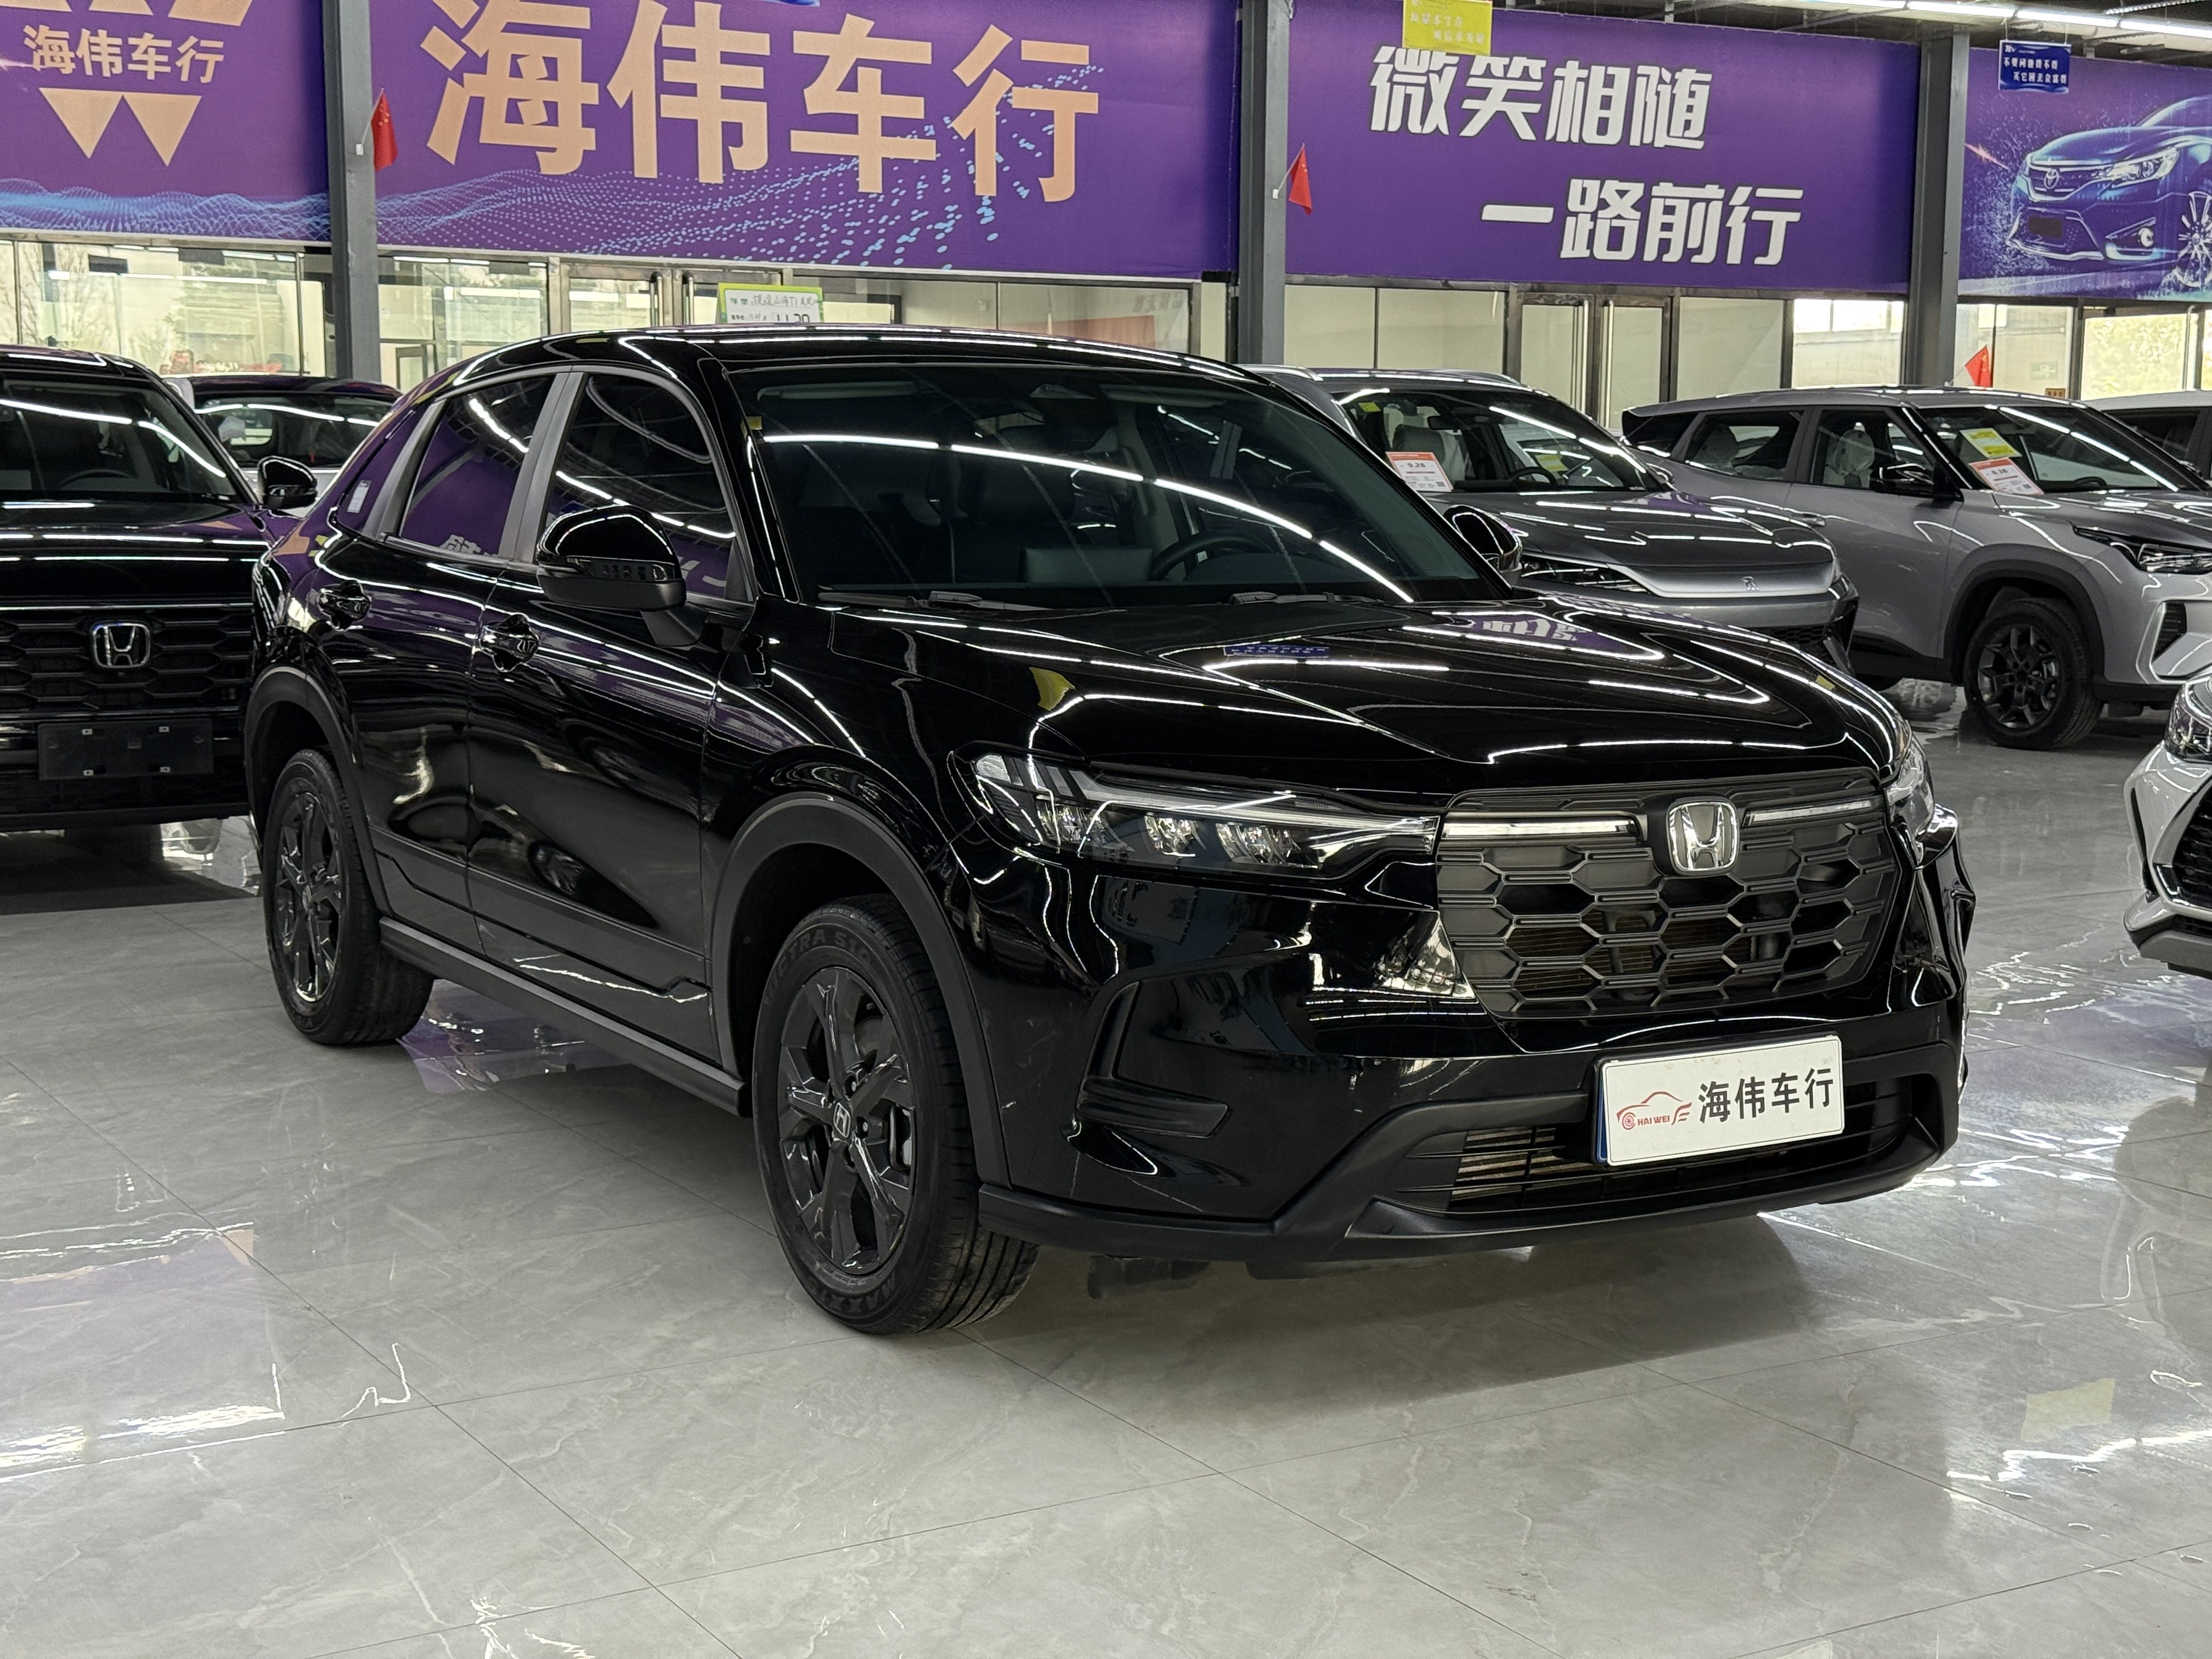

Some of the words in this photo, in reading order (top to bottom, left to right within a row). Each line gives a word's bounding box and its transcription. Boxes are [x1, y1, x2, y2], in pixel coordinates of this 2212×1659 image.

[23, 25, 224, 83] 海伟车行
[421, 0, 1098, 202] 海伟车行
[1369, 46, 1712, 150] 微笑相随
[1481, 179, 1804, 266] 一路前行
[1638, 1118, 1652, 1126] HAI
[1654, 1115, 1670, 1124] WEI
[1698, 1067, 1833, 1124] 海伟车行
